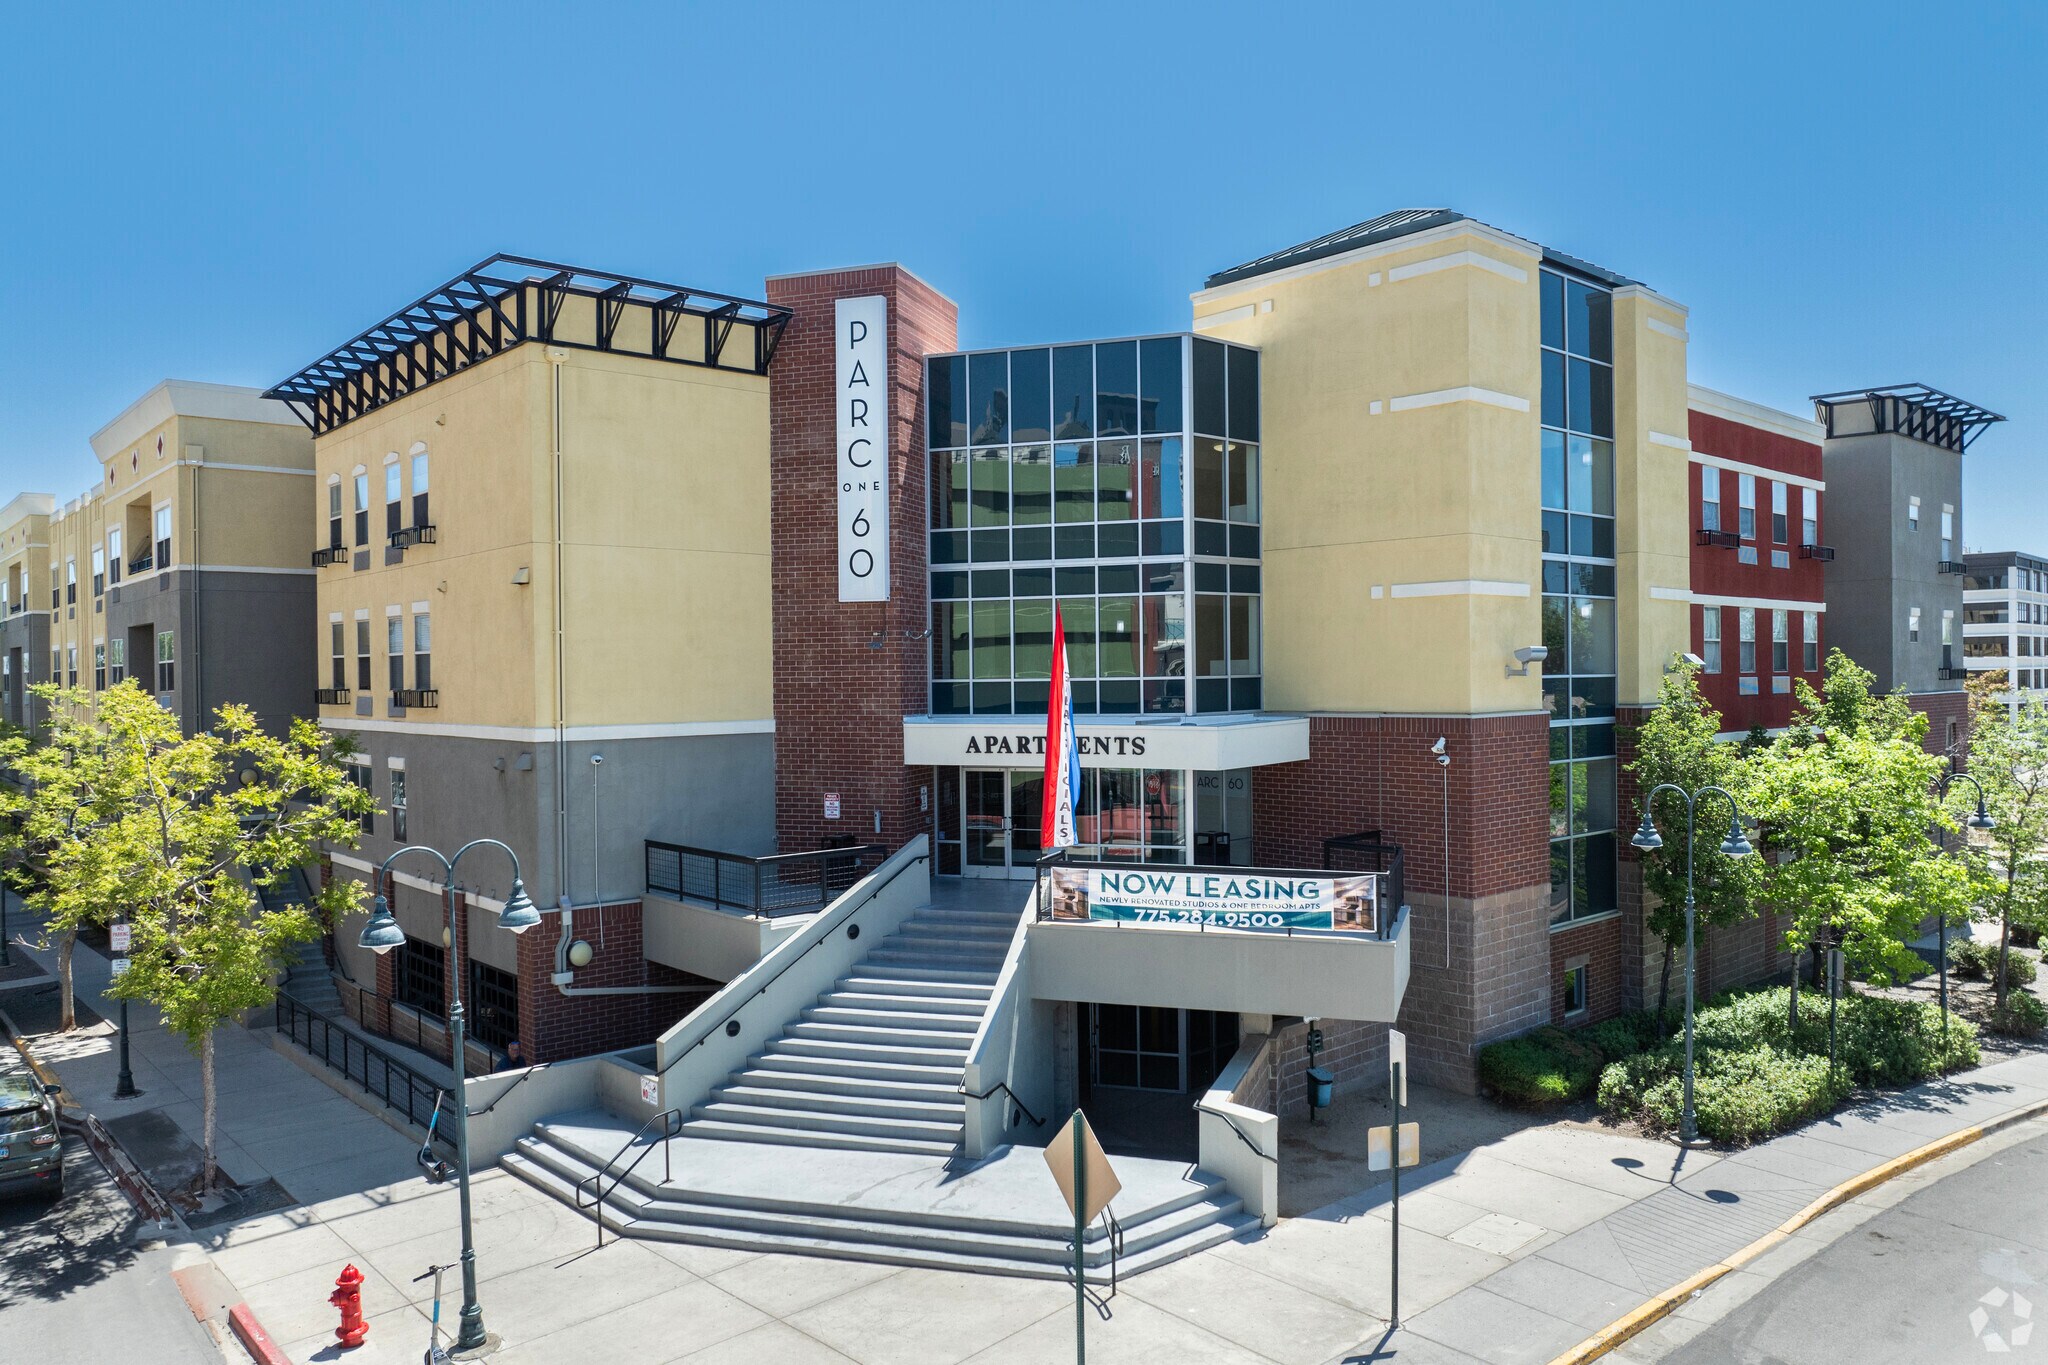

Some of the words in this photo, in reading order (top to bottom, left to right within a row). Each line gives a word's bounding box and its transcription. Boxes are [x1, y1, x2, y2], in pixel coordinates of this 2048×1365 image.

[848, 321, 872, 467] PARC
[842, 480, 880, 492] ONE
[849, 508, 874, 578] 60
[965, 735, 1146, 755] APARTENTS
[1196, 776, 1219, 789] ARC
[1228, 778, 1244, 790] 60
[1101, 872, 1176, 895] NOW
[1186, 876, 1320, 900] LEASING
[1099, 896, 1129, 904] NEWLY
[1131, 898, 1181, 907] RENOVATED
[1182, 900, 1220, 908] STUDIOS
[1134, 908, 1284, 928] 775.284.9500
